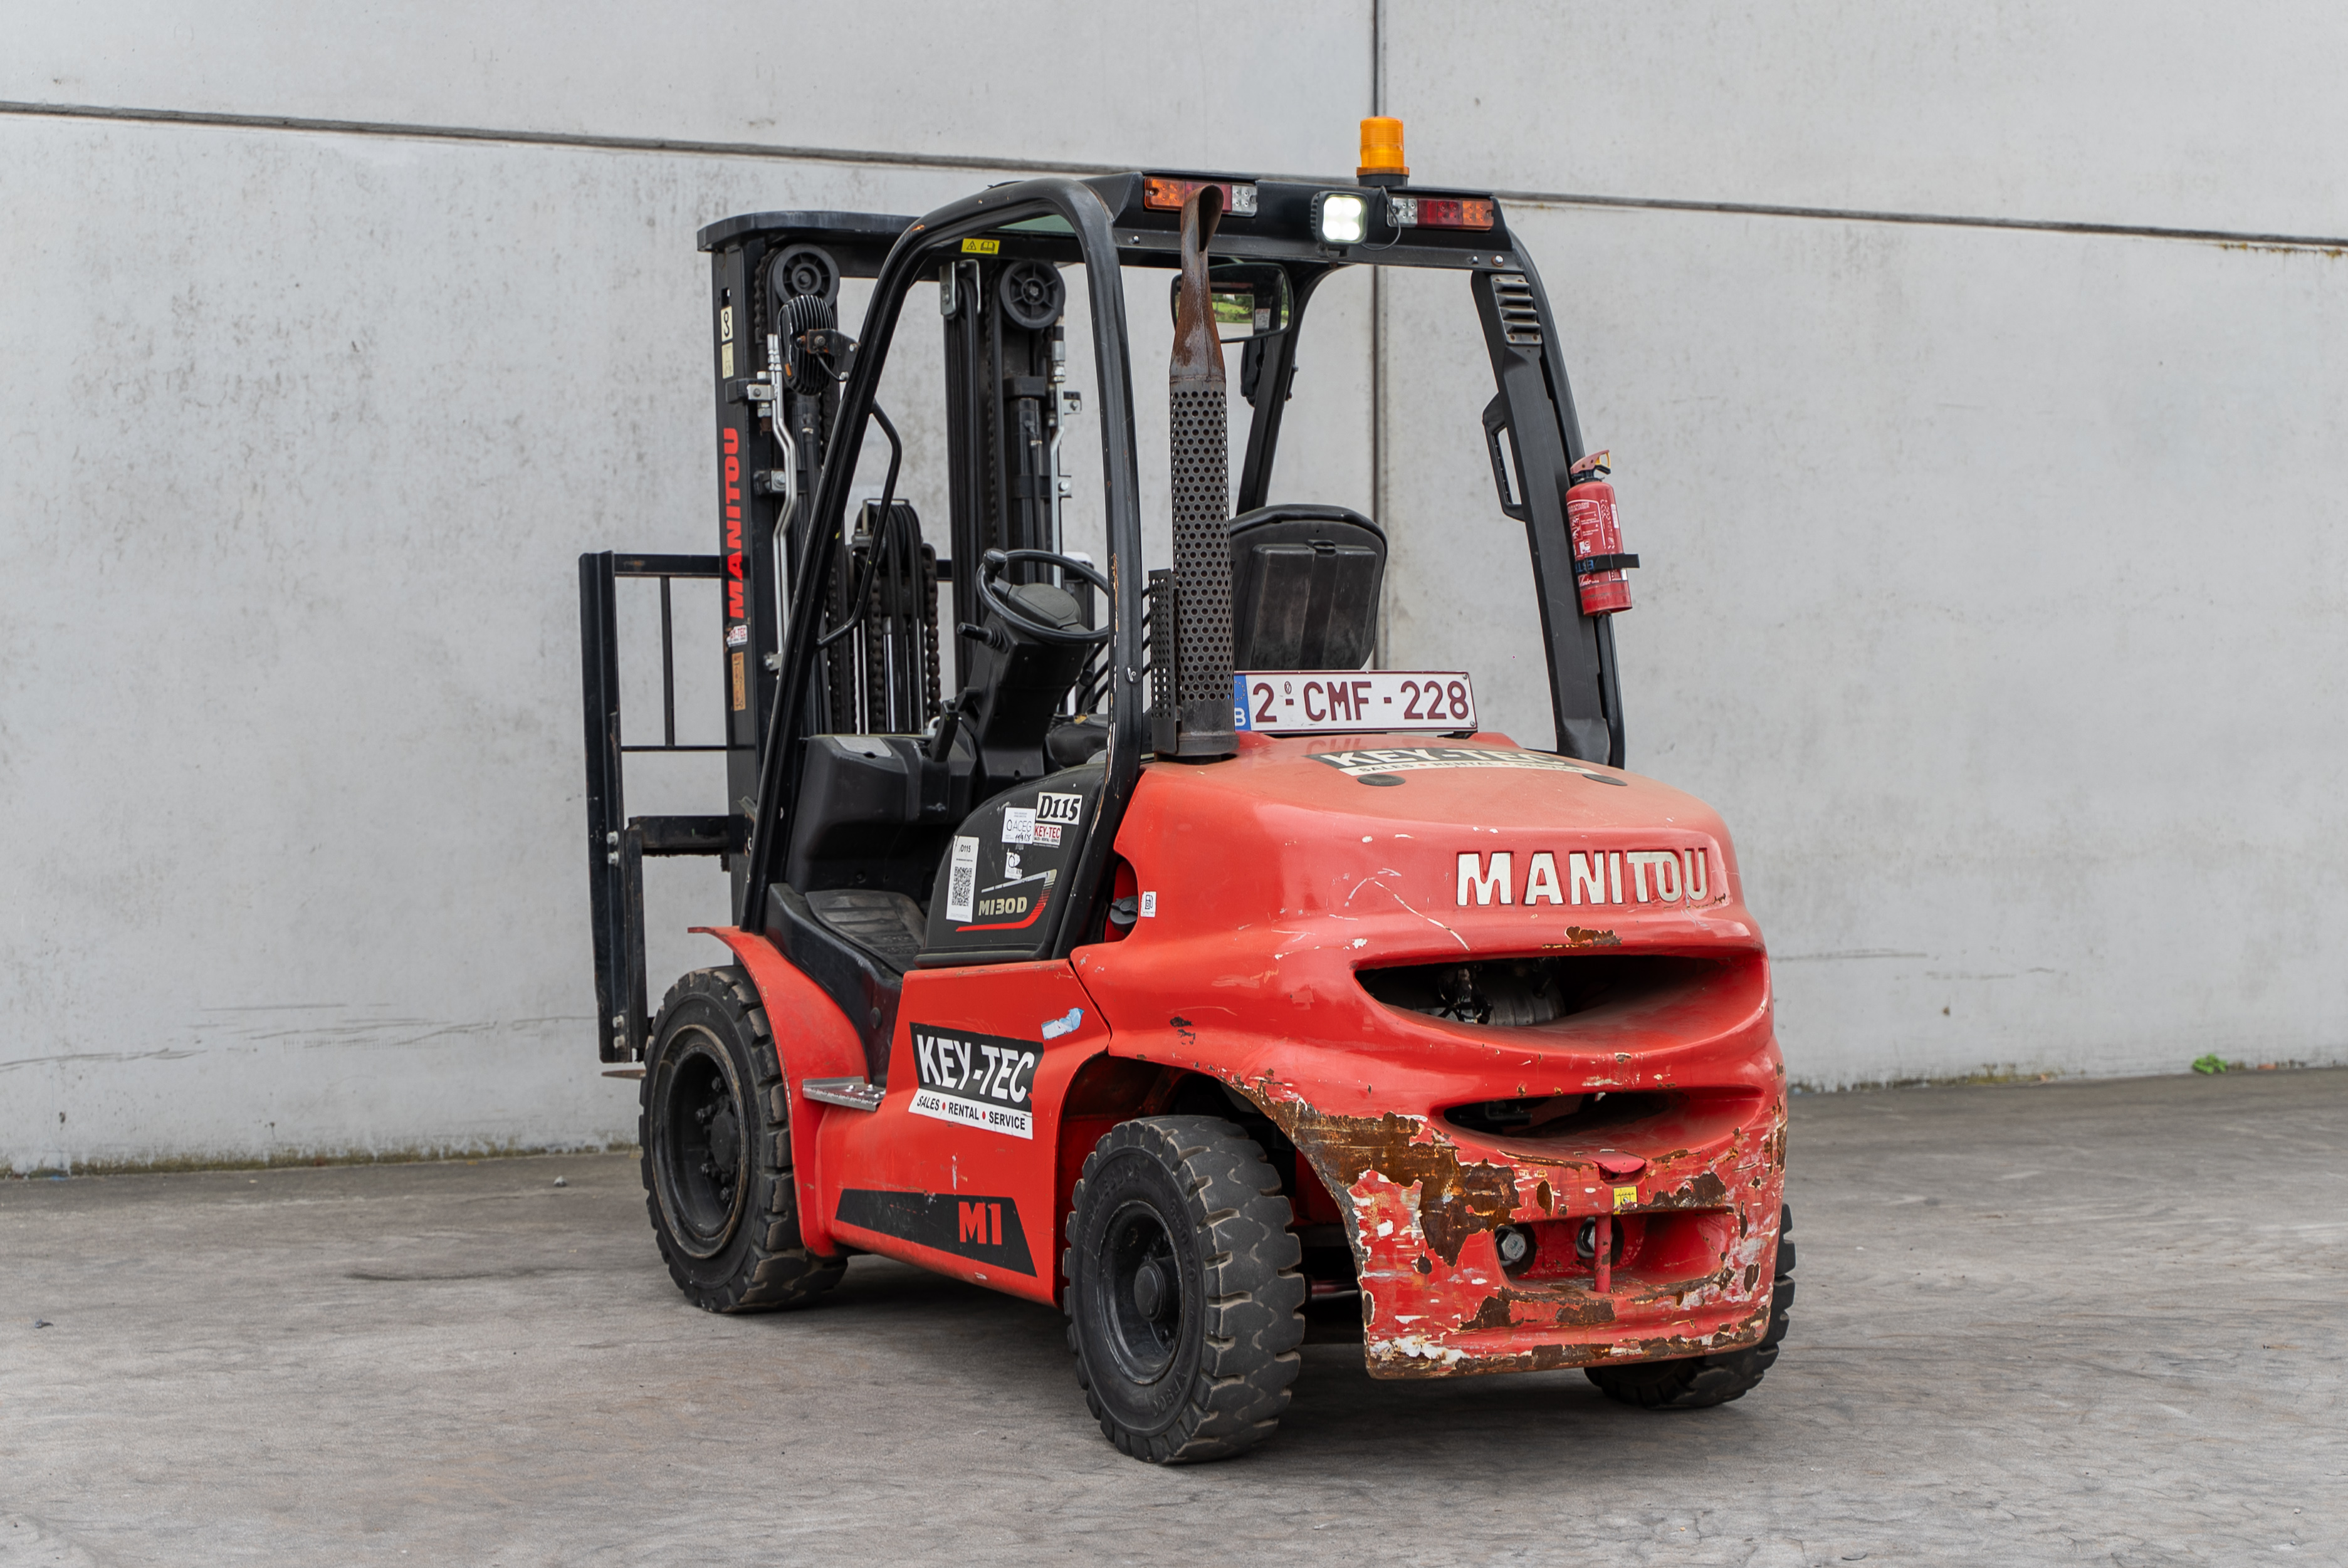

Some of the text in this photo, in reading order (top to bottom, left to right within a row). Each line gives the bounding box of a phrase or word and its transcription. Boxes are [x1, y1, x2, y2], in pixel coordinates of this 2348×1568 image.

[723, 427, 744, 619] MANITOU
[1234, 707, 1246, 726] B
[1320, 749, 1566, 766] KEY-TEC
[1358, 763, 1414, 772] SALES
[1037, 795, 1081, 822] D115
[1034, 825, 1061, 839] KEY-TEC
[1457, 850, 1708, 906] MANITOU
[916, 1034, 1035, 1103] KEY-TEC
[917, 1095, 1025, 1131] SALES RENTAL SERVICE
